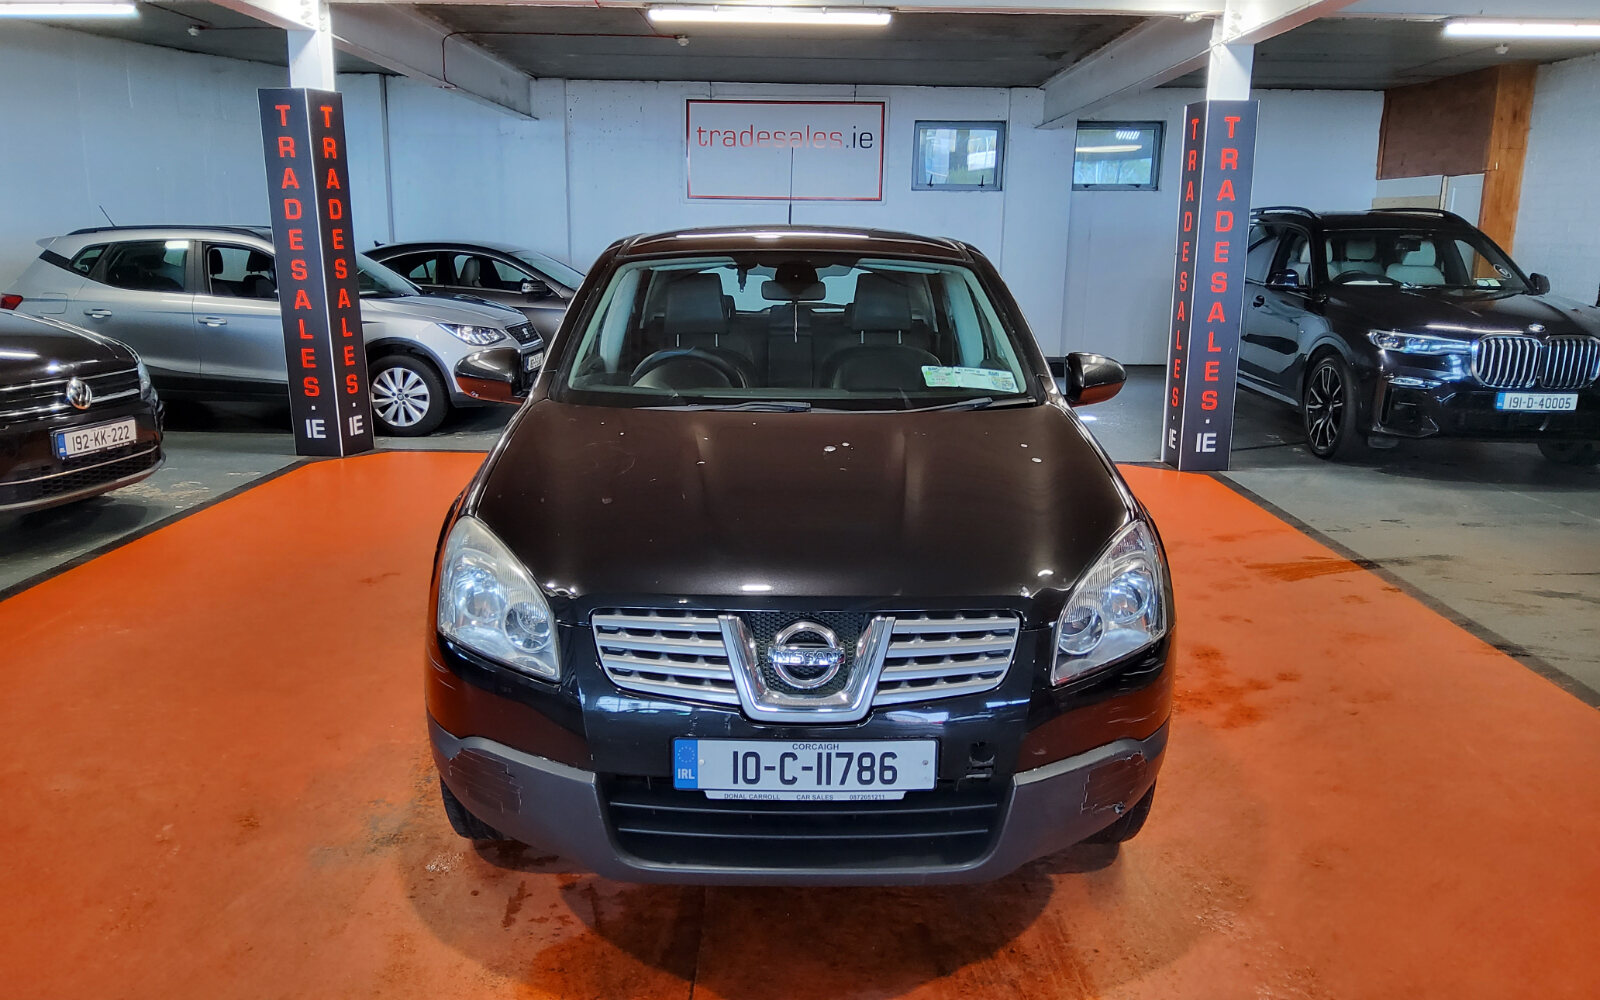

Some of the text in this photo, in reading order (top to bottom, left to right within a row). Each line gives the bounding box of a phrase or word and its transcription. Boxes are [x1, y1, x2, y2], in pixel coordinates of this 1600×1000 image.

[696, 124, 873, 149] tradesales.ie
[1508, 396, 1572, 409] 191-D-40005
[72, 425, 130, 452] 192-KK-222
[792, 743, 840, 751] CORCAIGH
[677, 768, 695, 780] IRL
[732, 751, 898, 785] 10-C-11786
